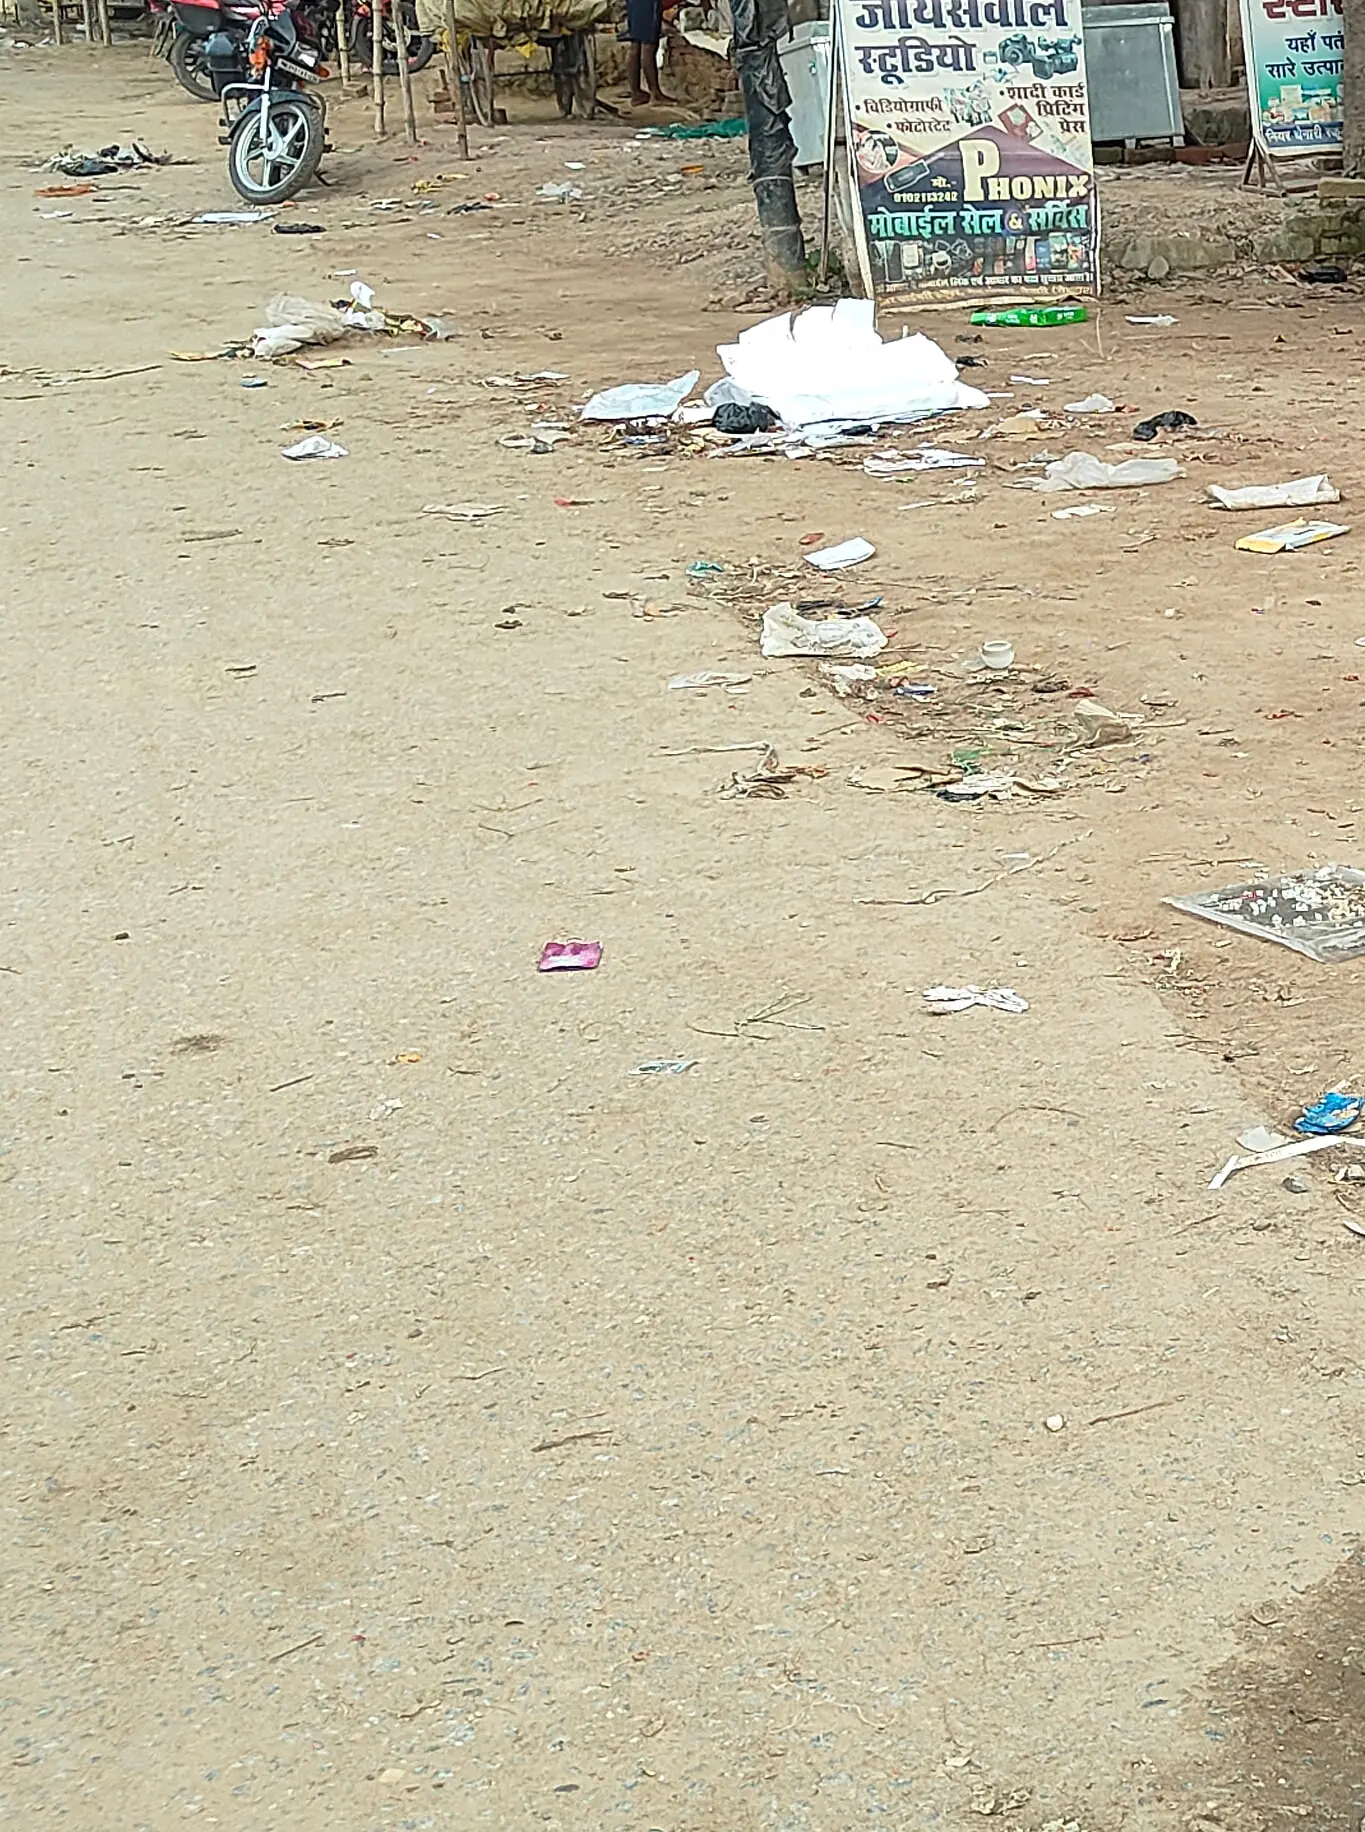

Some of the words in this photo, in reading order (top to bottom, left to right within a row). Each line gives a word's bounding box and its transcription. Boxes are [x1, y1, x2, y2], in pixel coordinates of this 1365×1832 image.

[854, 35, 977, 84] स्टूडियो
[1265, 57, 1297, 78] सारे
[1301, 59, 1345, 76] उत्पा
[1005, 83, 1047, 99] शादी
[1050, 82, 1086, 98] कार्ड
[1058, 117, 1086, 133] प्रेस
[867, 205, 958, 238] मोबाईल
[958, 204, 1003, 235] सेल
[1007, 213, 1023, 230] &
[1027, 200, 1088, 231] सर्विस
